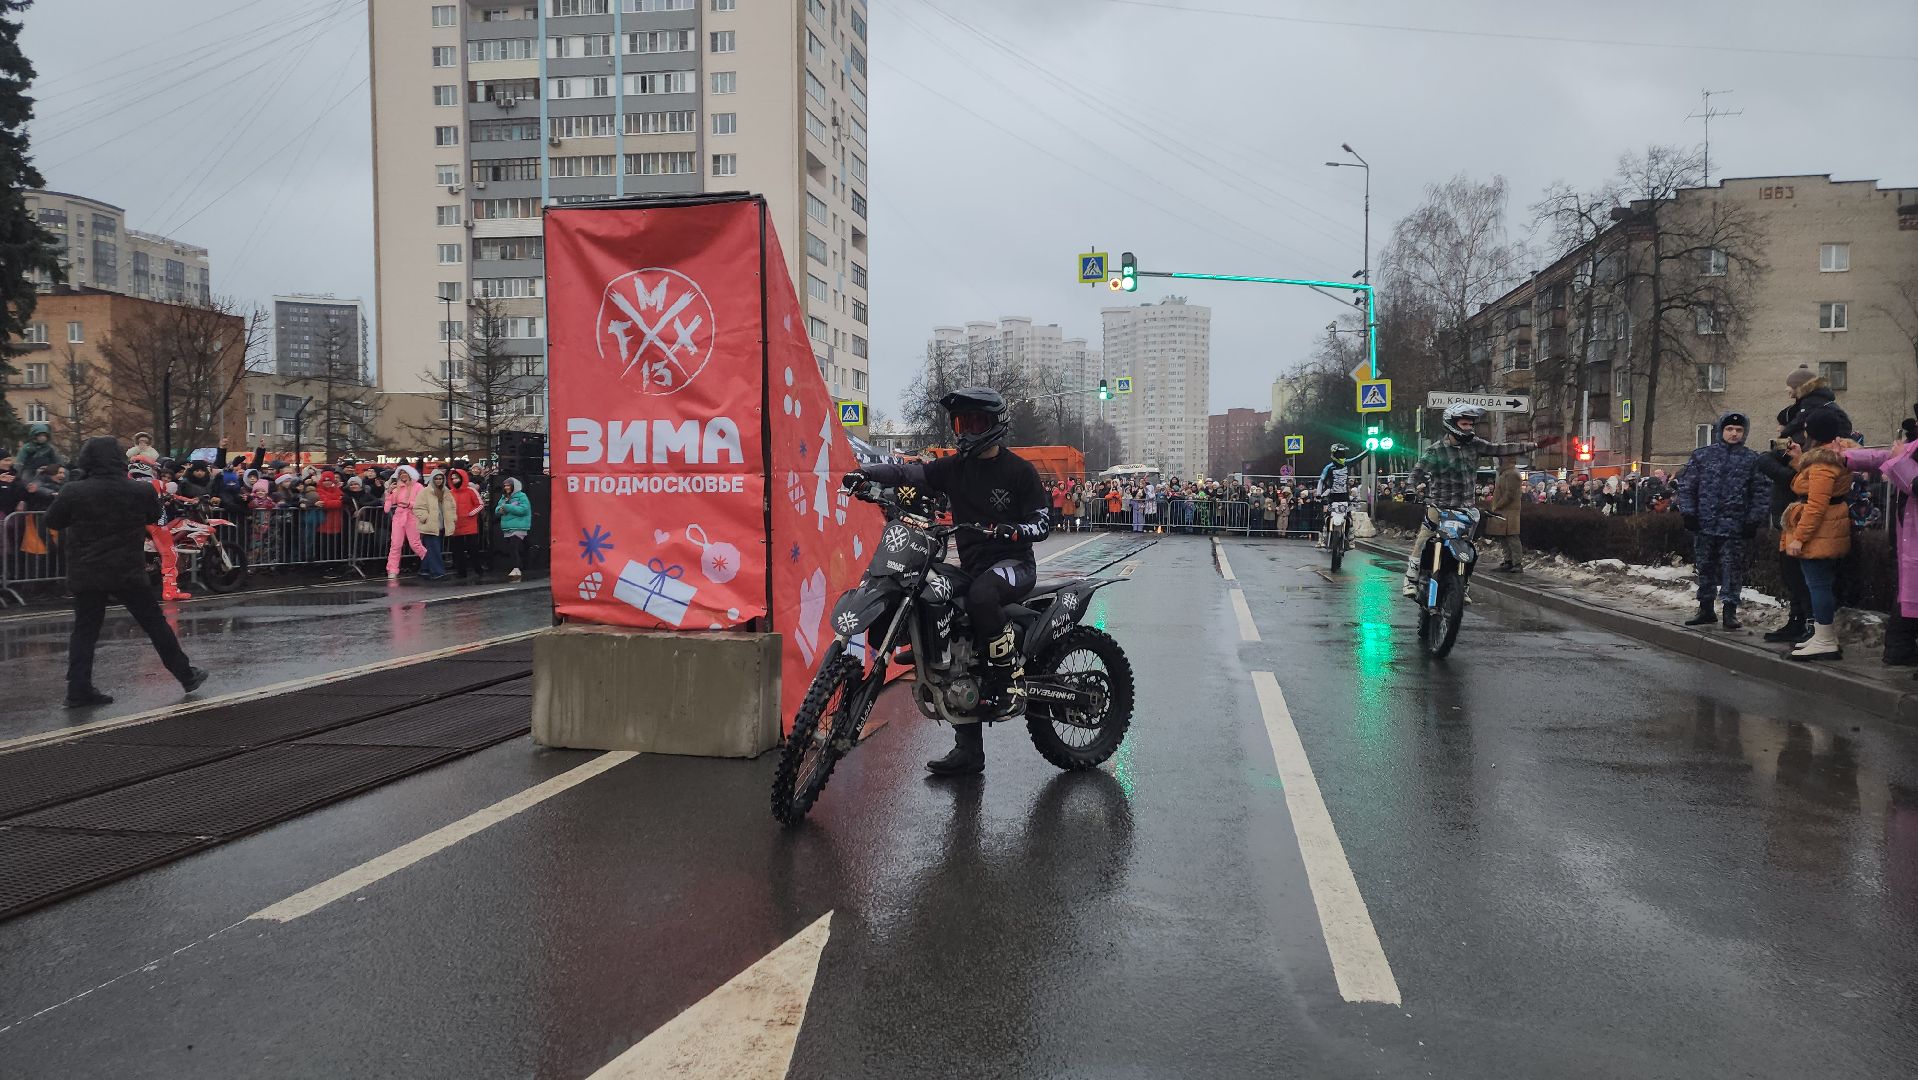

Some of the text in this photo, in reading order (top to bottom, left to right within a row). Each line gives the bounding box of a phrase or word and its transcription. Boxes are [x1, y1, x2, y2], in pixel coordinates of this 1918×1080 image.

[1431, 396, 1502, 407] ул. КРЫЛОВА
[566, 416, 745, 465] ЗИМА
[567, 476, 744, 496] В ПОДМОСКОВЬЕ
